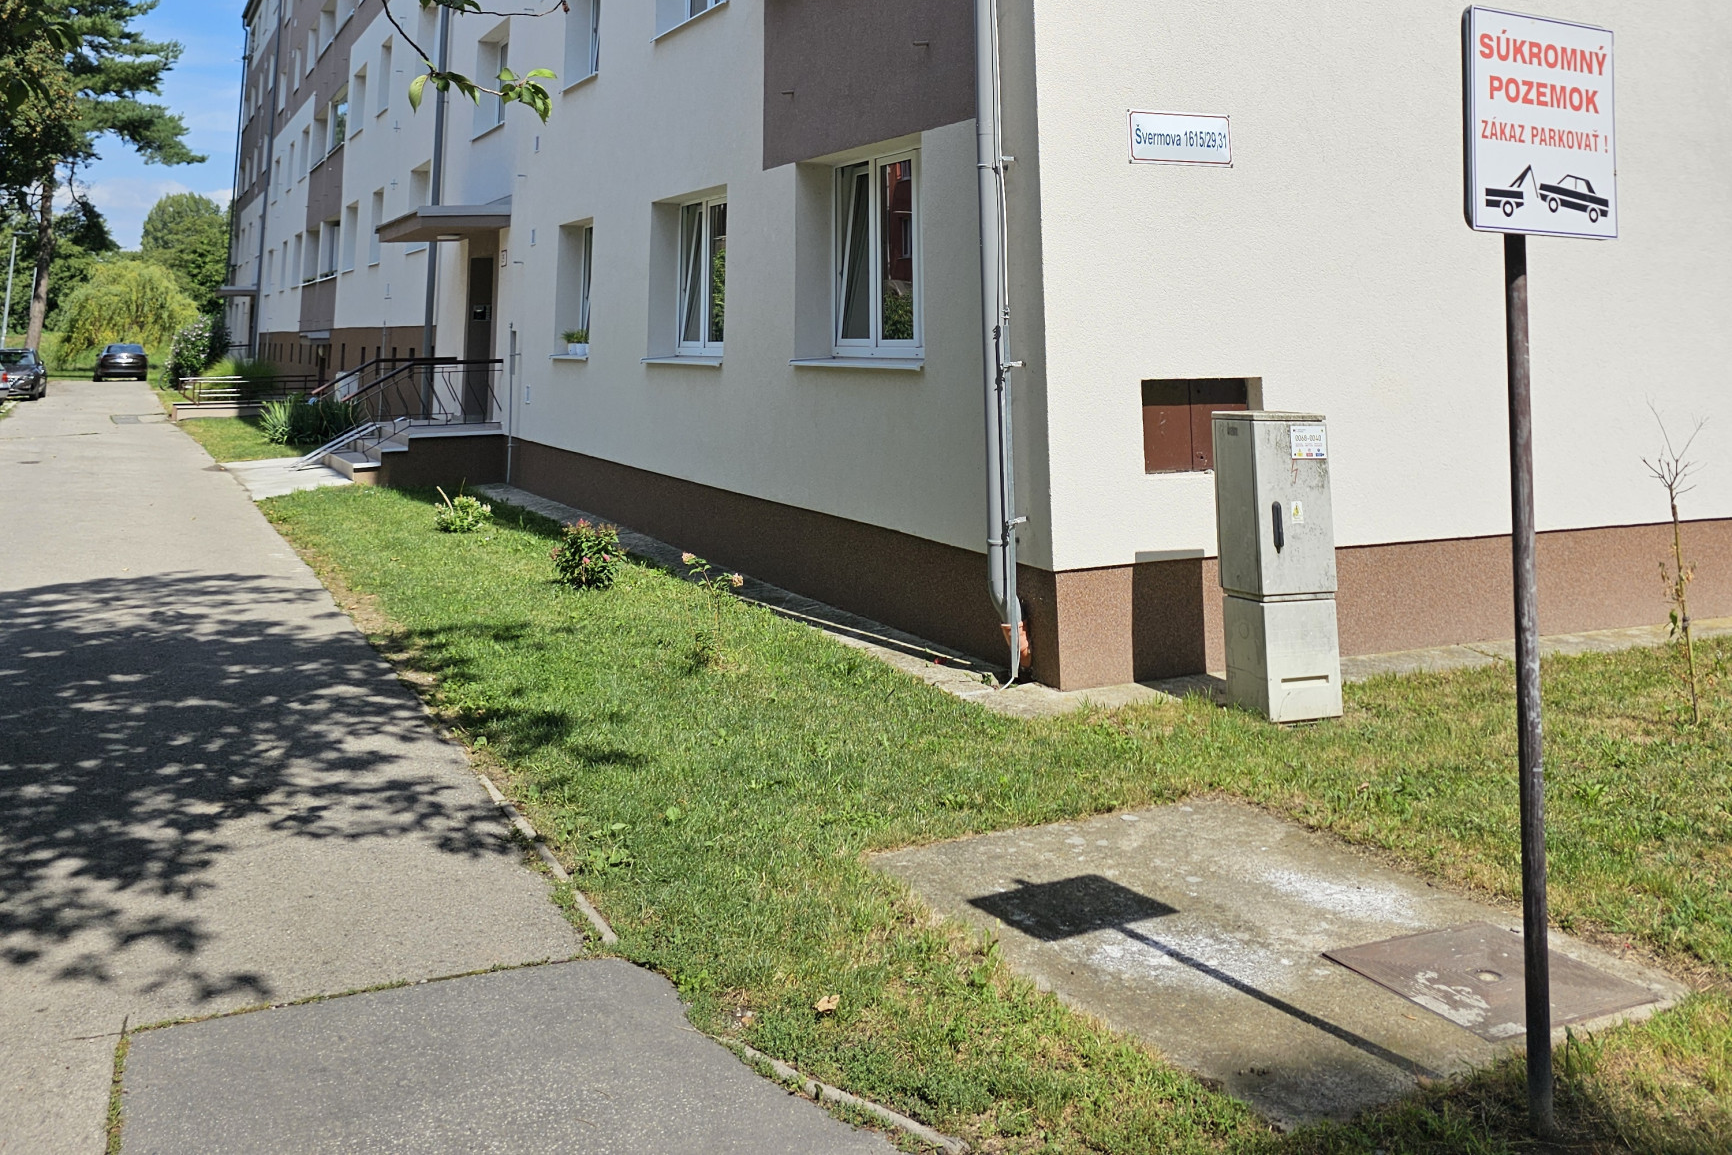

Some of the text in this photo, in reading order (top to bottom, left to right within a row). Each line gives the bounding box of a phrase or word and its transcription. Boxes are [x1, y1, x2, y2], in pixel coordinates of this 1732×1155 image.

[1479, 29, 1608, 76] SÚKROMNÝ
[1489, 75, 1599, 114] POZEMOK
[1135, 124, 1227, 152] Švermova 1615/29,31
[1481, 116, 1608, 154] ZÁKAZ PARKOVAŤ !
